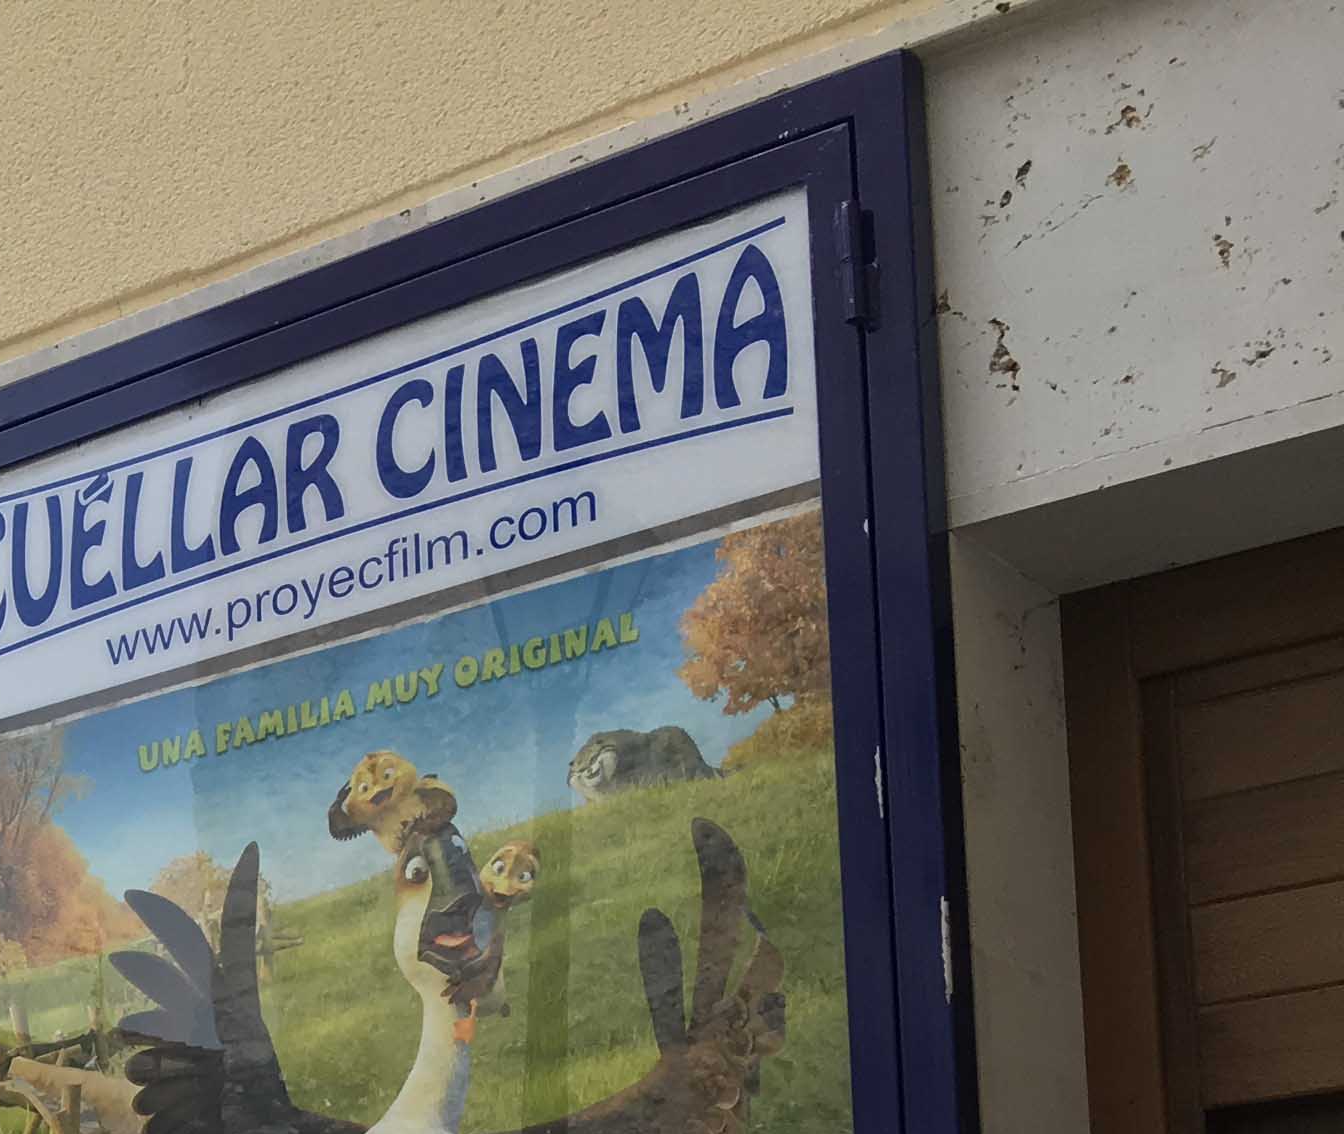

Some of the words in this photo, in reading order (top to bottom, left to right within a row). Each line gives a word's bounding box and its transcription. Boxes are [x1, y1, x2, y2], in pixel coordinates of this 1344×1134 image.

[375, 242, 789, 499] CINEMA
[106, 486, 597, 664] www.proyecfilm.com
[137, 729, 206, 772] UNA
[216, 689, 355, 754] FAMILIA
[364, 663, 446, 712] MUY
[453, 611, 641, 687] ORIGINAL
